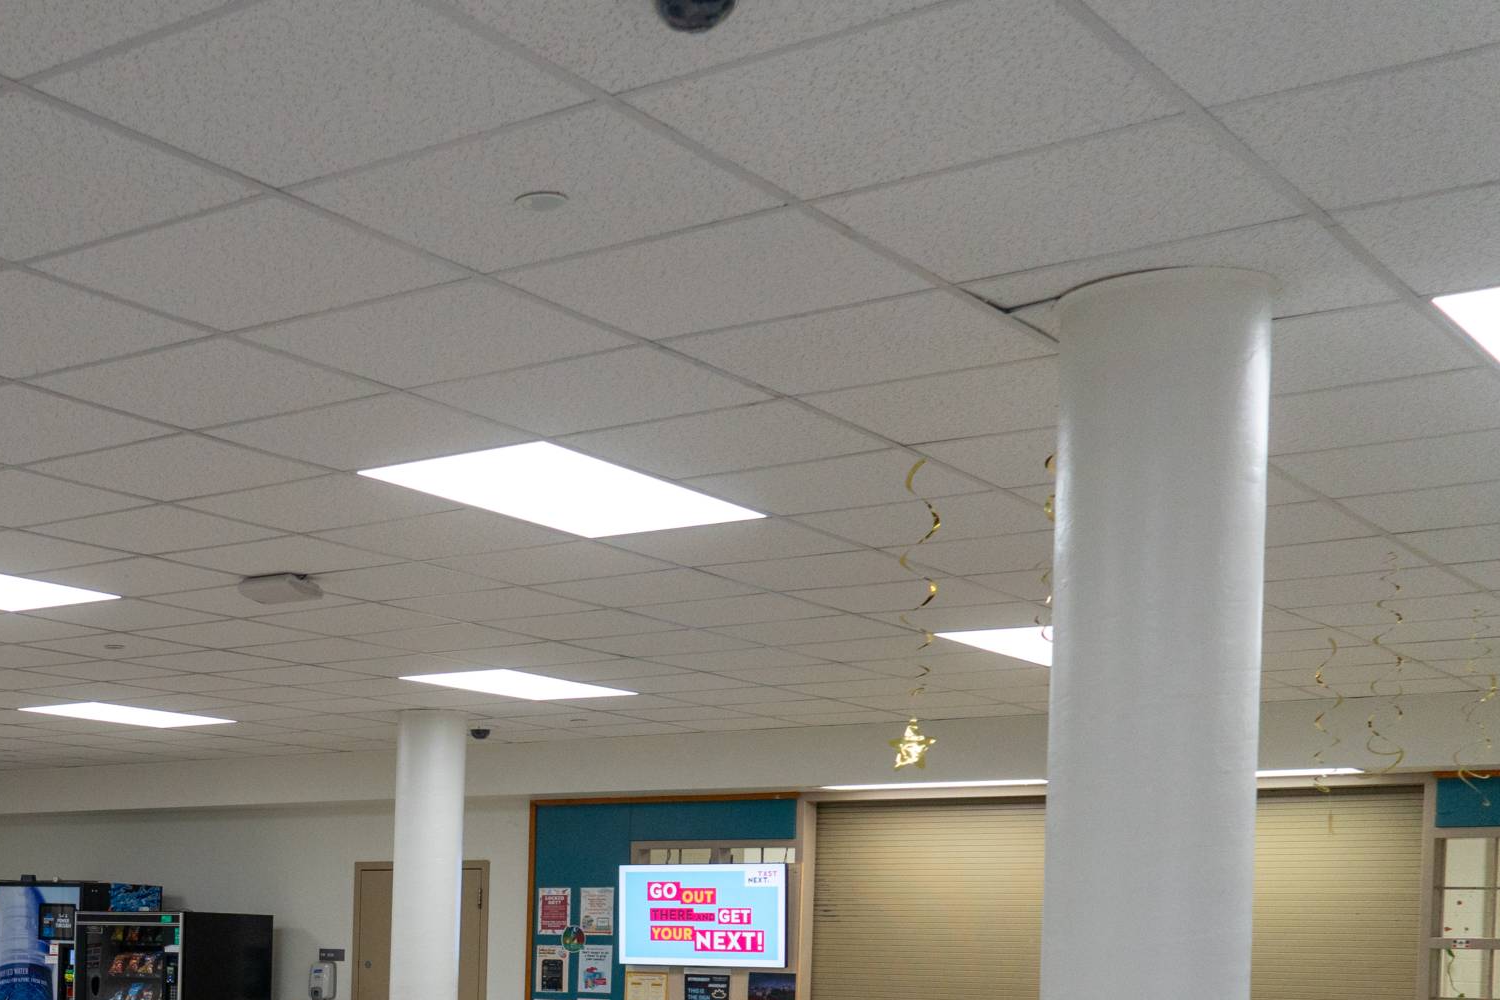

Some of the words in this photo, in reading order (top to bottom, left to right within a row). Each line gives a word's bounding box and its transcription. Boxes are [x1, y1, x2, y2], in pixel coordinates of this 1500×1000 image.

[649, 883, 677, 899] GO
[681, 890, 714, 904] OUT
[651, 909, 693, 921] THERE
[695, 913, 715, 921] AND
[718, 909, 750, 923] GET
[651, 927, 693, 940] YOUR
[695, 931, 763, 951] NEXT!
